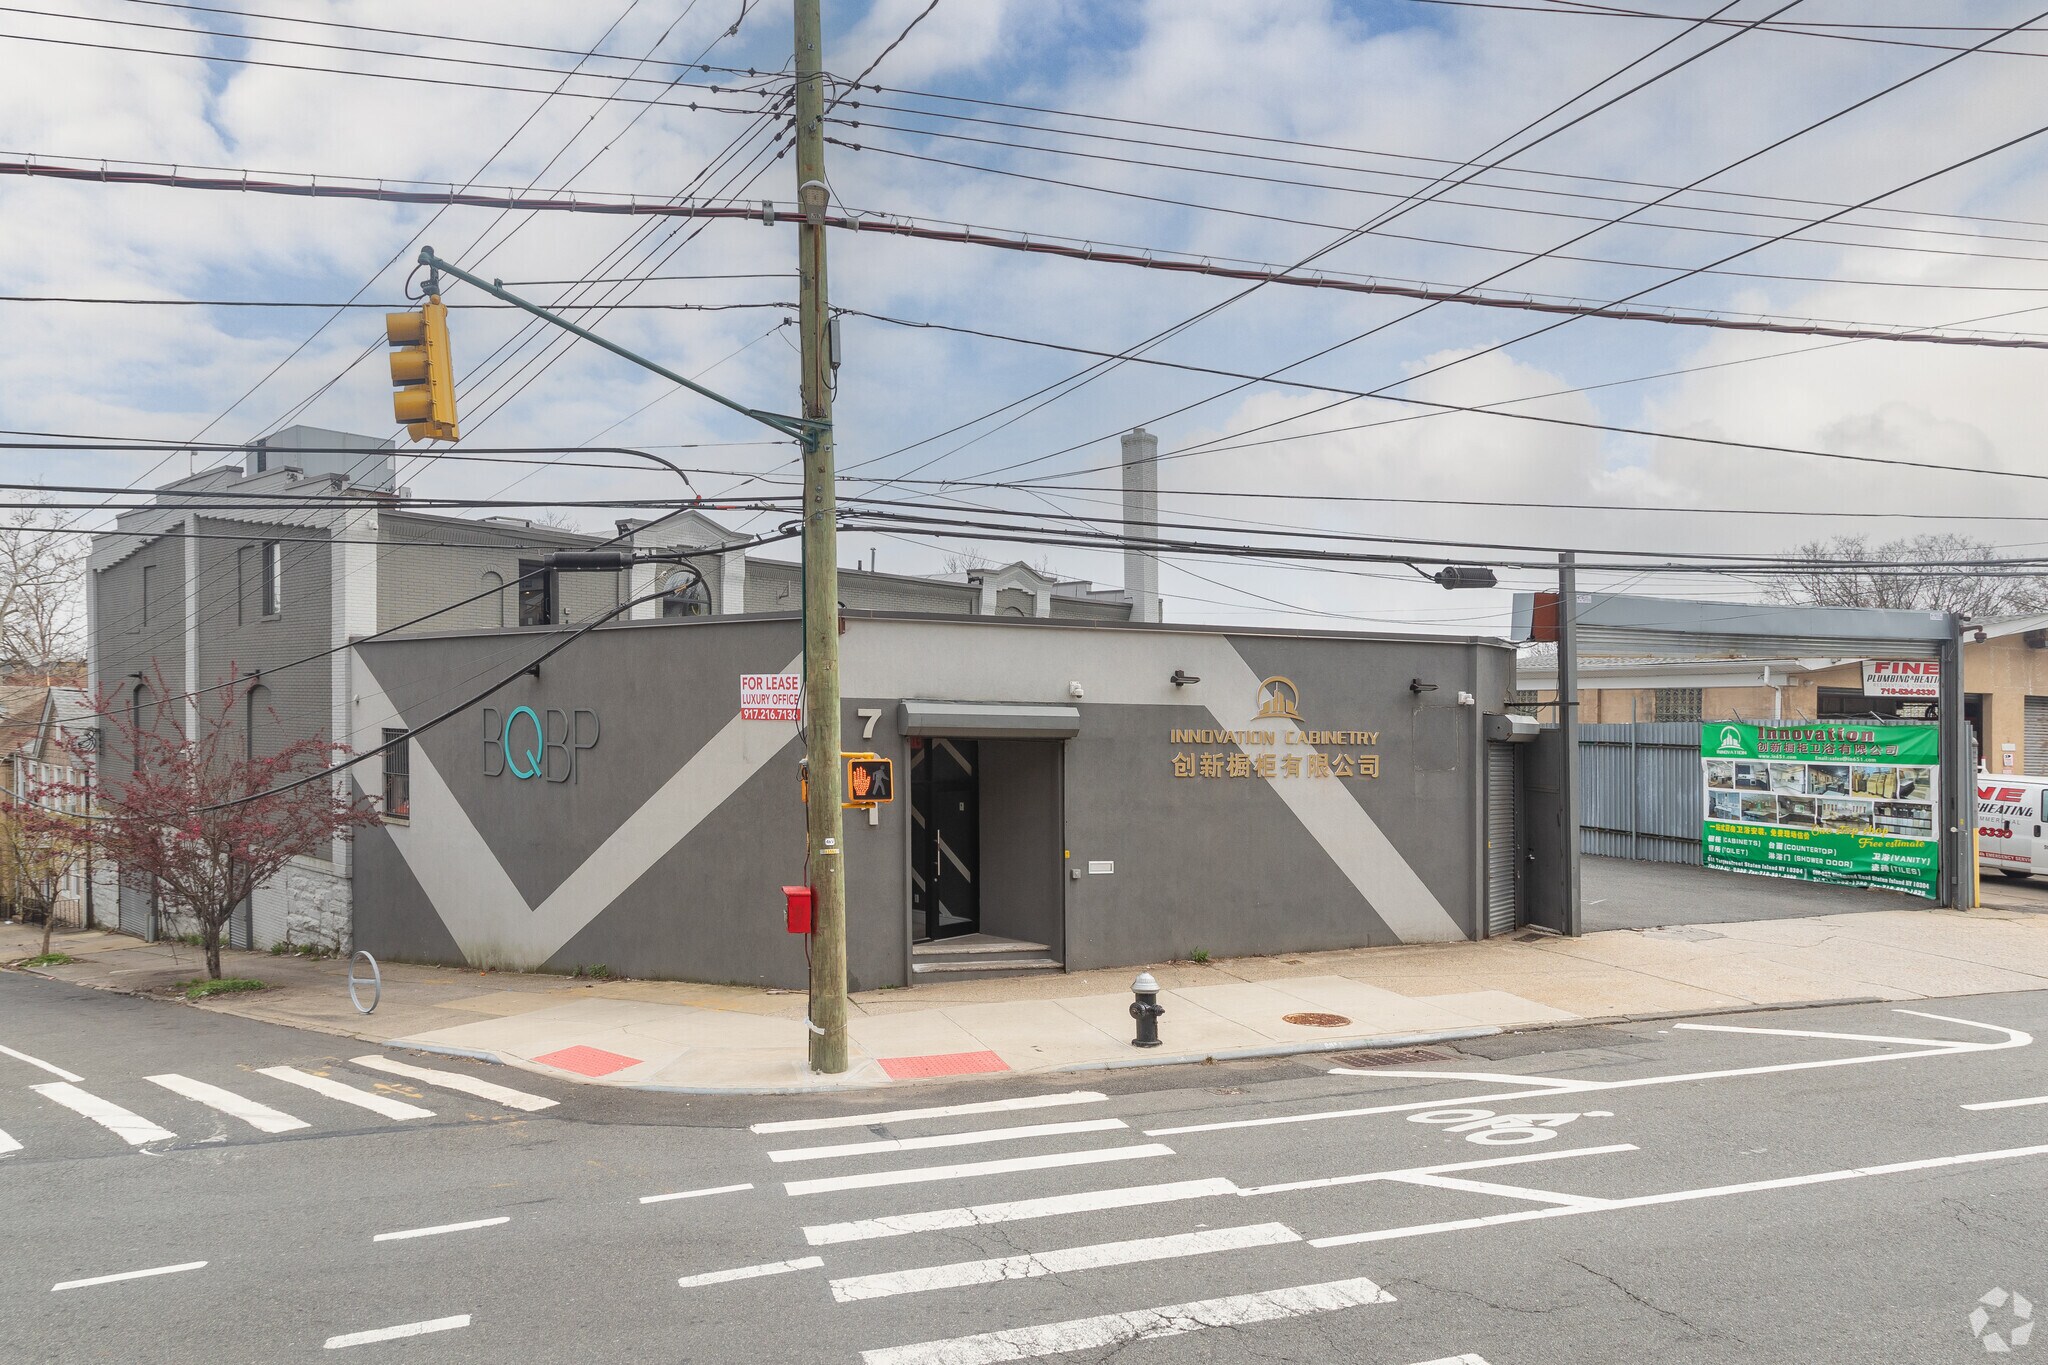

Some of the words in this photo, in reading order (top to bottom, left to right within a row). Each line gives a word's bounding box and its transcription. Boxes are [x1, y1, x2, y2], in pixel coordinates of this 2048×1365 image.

[1875, 662, 1939, 675] FINE
[742, 677, 763, 690] FOR
[766, 677, 798, 690] LEASE
[742, 694, 770, 705] LUXURY
[772, 694, 798, 705] OFFICE
[744, 709, 798, 720] 917.216.7136
[1170, 729, 1274, 745] INNOVATION
[1285, 730, 1380, 745] CABINETRY
[1758, 726, 1874, 742] Innovation
[1171, 752, 1380, 778] 创新橱柜有限公司
[1858, 838, 1884, 848] Free
[1885, 839, 1925, 848] estimate
